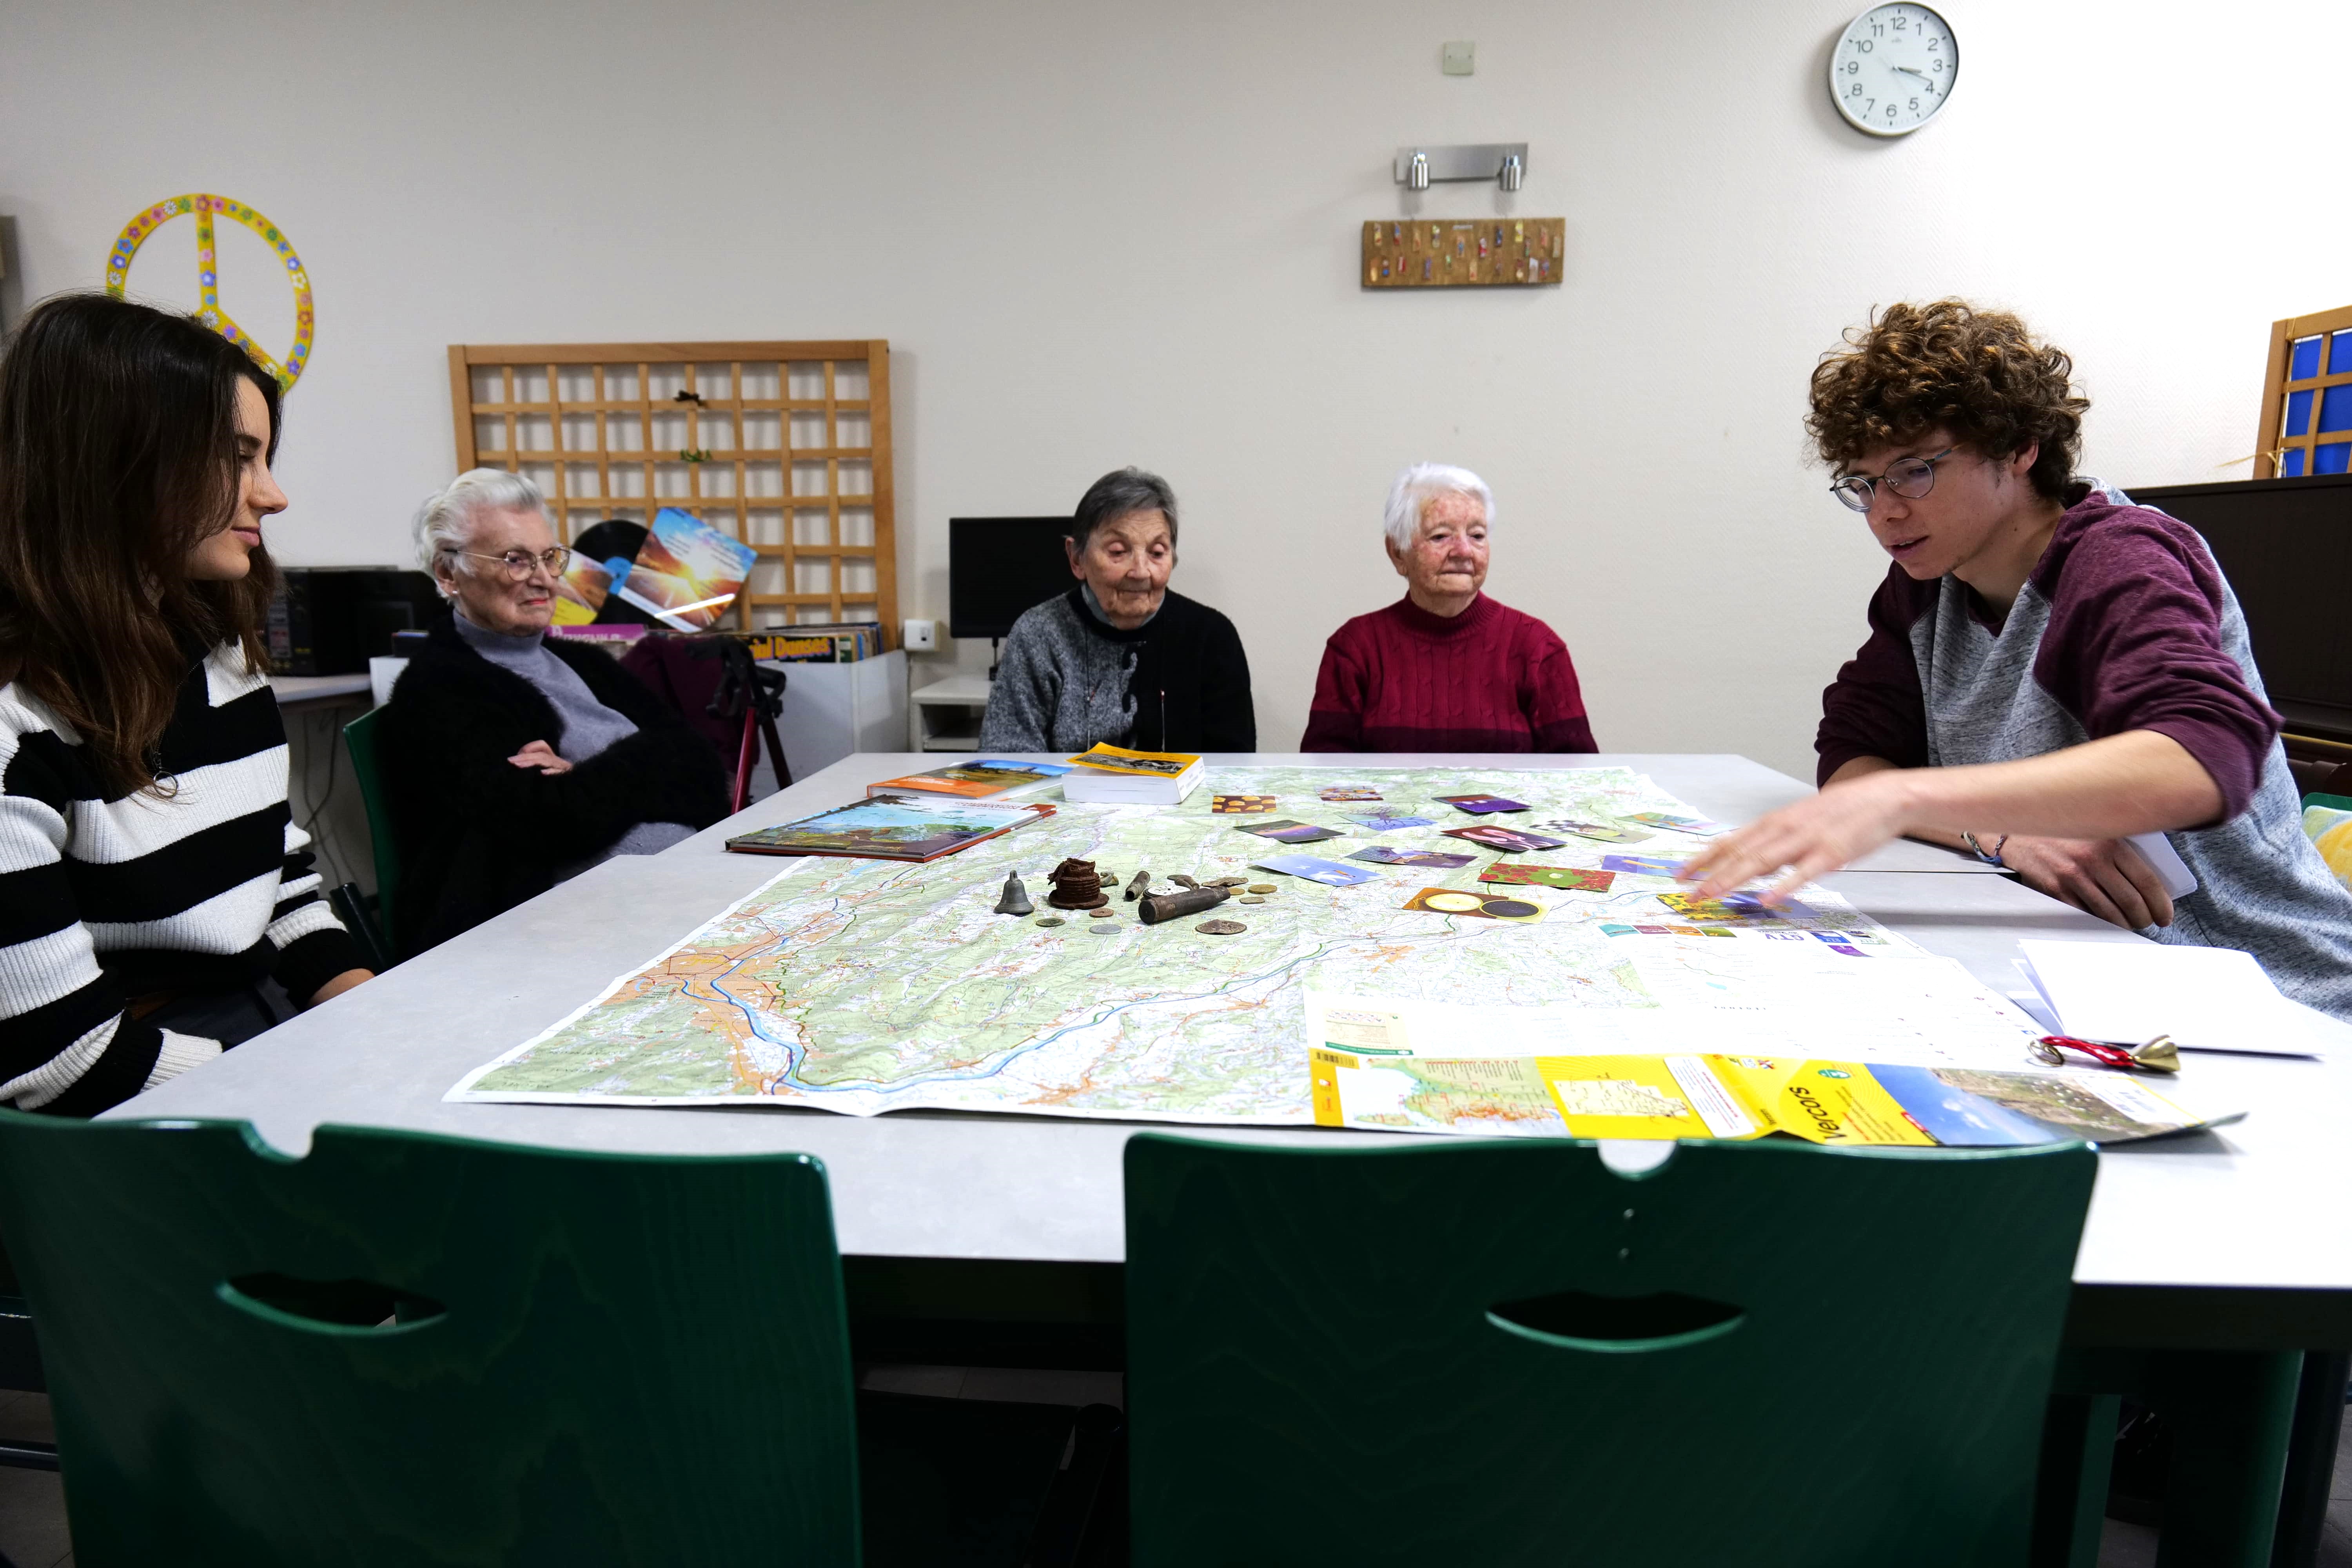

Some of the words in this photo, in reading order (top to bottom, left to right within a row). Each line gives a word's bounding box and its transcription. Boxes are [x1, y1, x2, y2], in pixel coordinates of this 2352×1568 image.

[1871, 24, 1884, 36] 11
[1890, 17, 1906, 30] 12
[1916, 23, 1922, 35] 1
[1855, 40, 1873, 53] 10
[1927, 38, 1938, 51] 2
[1848, 62, 1858, 74] 9
[1932, 59, 1943, 72] 3
[1851, 83, 1862, 96] 8
[1925, 80, 1935, 94] 4
[1866, 99, 1875, 111] 7
[1886, 104, 1896, 117] 6
[1909, 98, 1918, 110] 5
[1789, 1087, 1847, 1139] Vercors
